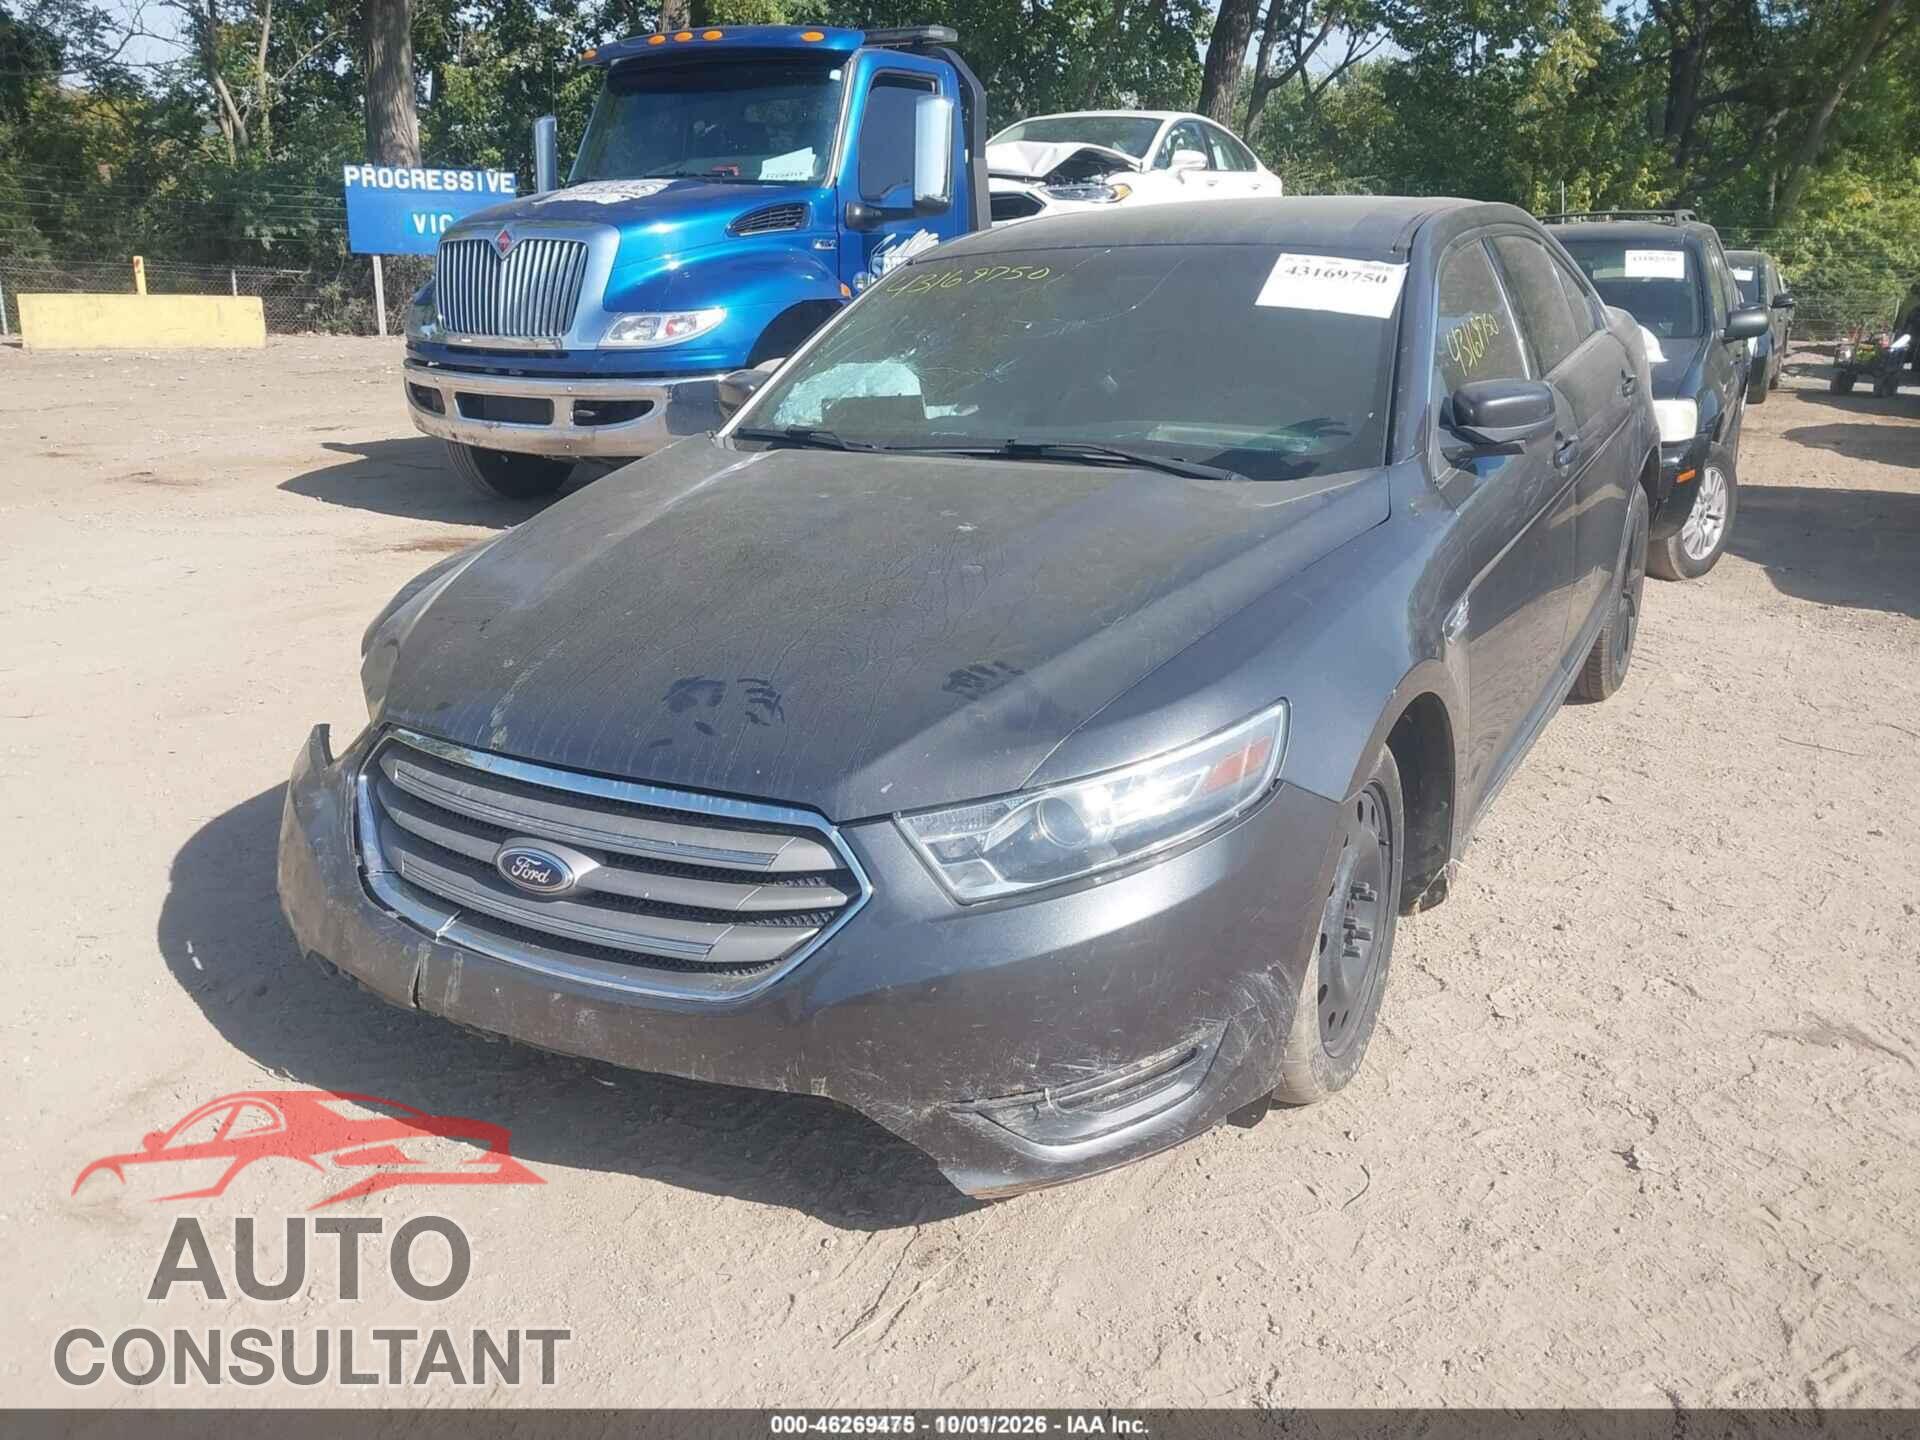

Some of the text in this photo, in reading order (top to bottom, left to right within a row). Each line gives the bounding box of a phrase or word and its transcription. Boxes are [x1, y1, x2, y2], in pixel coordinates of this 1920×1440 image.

[344, 164, 515, 193] PROGRESSIVE
[1285, 265, 1388, 284] 43169750
[511, 856, 551, 883] Ford
